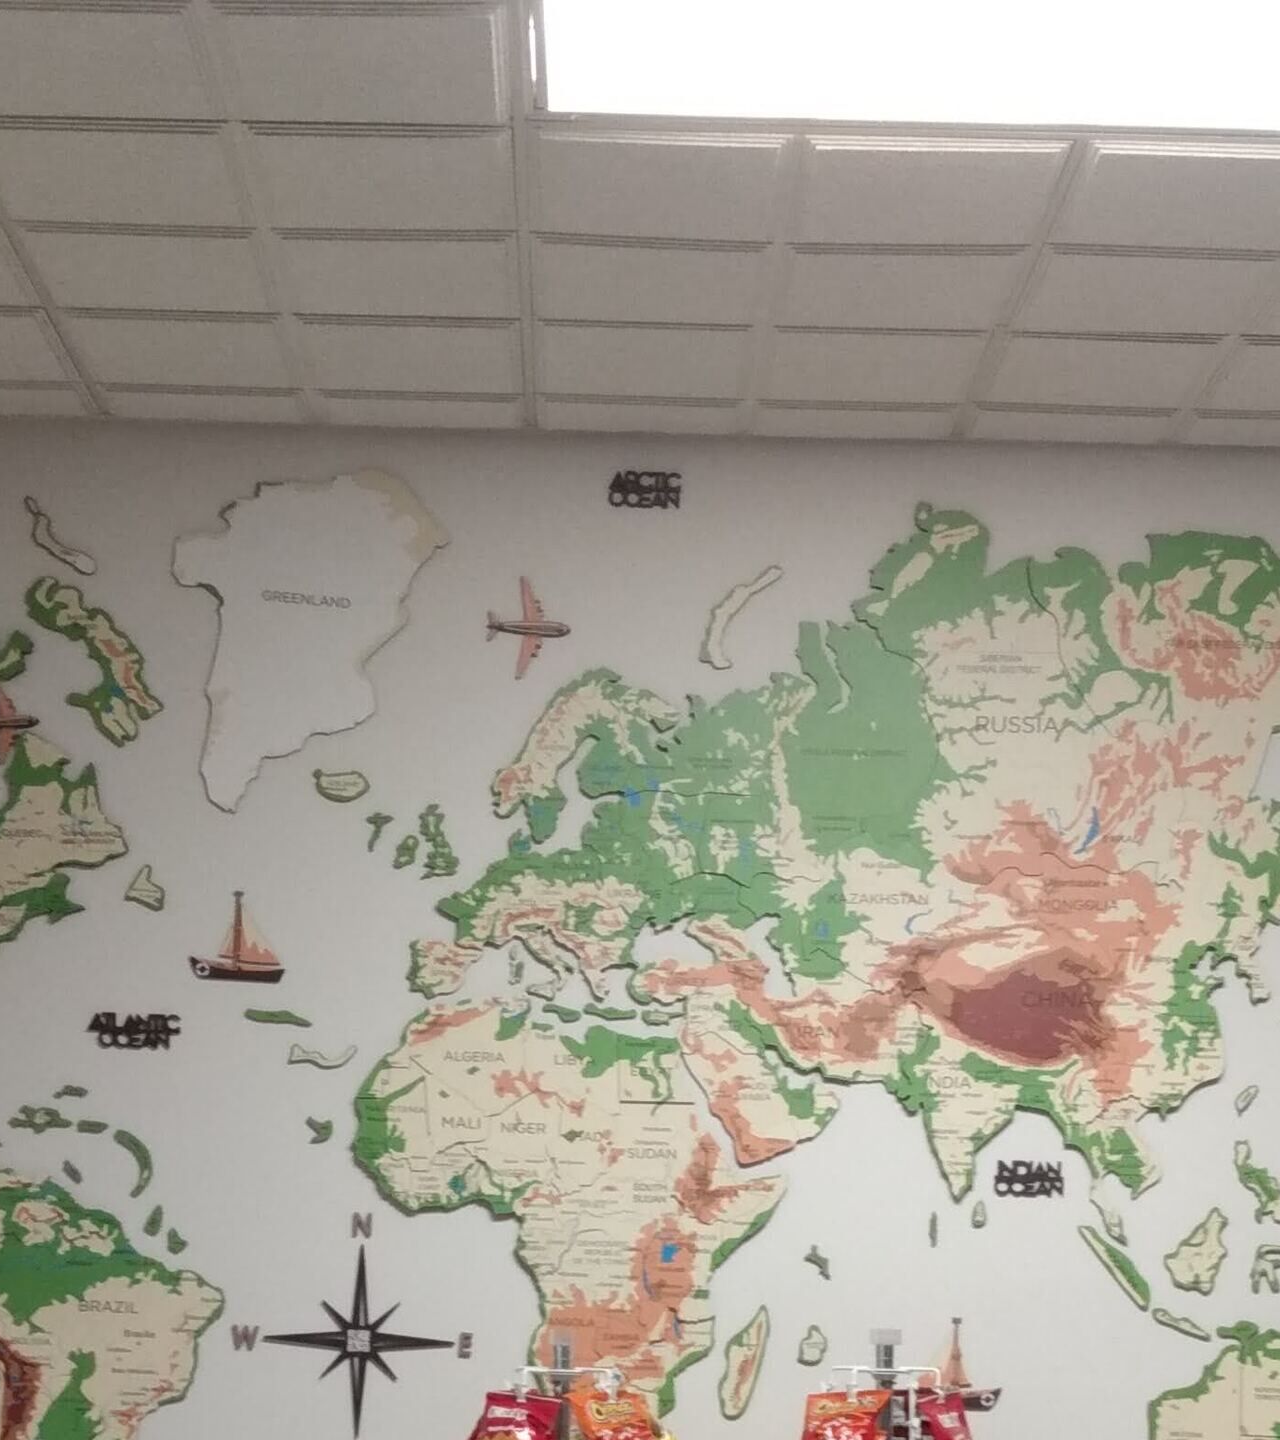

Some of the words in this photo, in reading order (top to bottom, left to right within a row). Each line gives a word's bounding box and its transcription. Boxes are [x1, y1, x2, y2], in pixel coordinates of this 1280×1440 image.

[609, 470, 682, 491] ARCTIC
[608, 489, 680, 509] OCEAN
[261, 589, 352, 609] GREENLAND
[974, 715, 1058, 734] RUSSIA
[1022, 990, 1094, 1008] CHINA
[86, 1011, 182, 1035] ATLANTIC
[99, 1030, 171, 1051] OCEAN
[443, 1050, 505, 1064] ALGERIA
[926, 1075, 973, 1089] NDIA
[441, 1116, 481, 1130] MALI
[500, 1121, 547, 1135] NIGER
[626, 1148, 677, 1160] SUDAN
[994, 1177, 1064, 1198] OCEAN
[351, 1211, 373, 1239] N
[77, 1300, 139, 1315] BRAZIL
[230, 1324, 260, 1352] W
[457, 1331, 474, 1360] E
